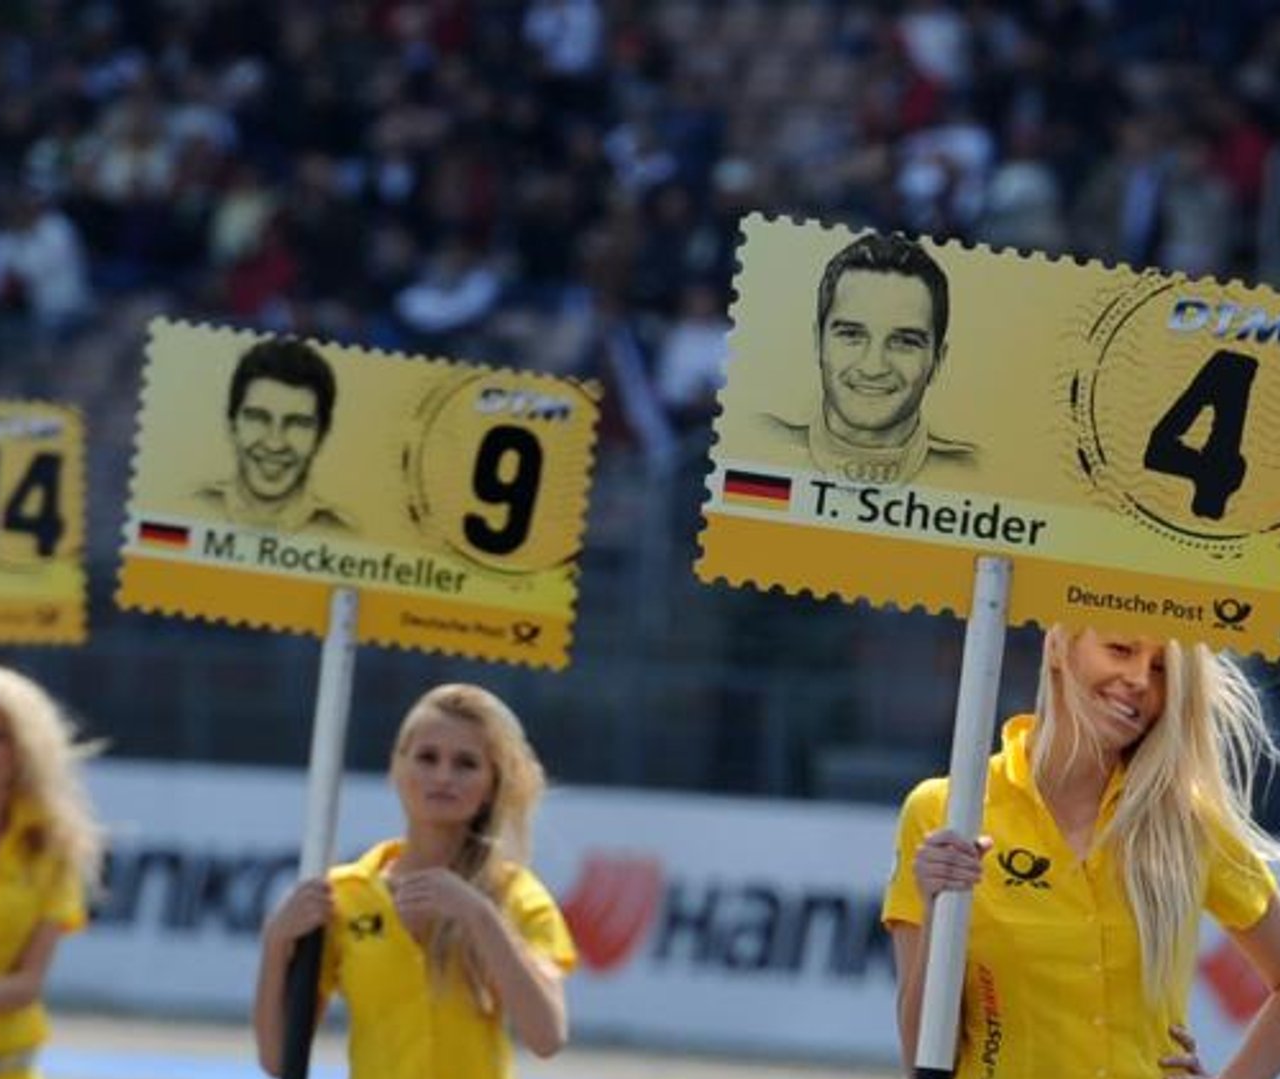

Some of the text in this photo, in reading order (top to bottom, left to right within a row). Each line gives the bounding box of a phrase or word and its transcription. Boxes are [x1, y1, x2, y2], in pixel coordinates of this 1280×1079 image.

[1144, 349, 1259, 521] 4
[463, 423, 543, 556] 9
[810, 480, 1047, 546] T. Scheider
[204, 529, 469, 595] M. Rockenfeller
[1066, 584, 1204, 622] Deutsche Post
